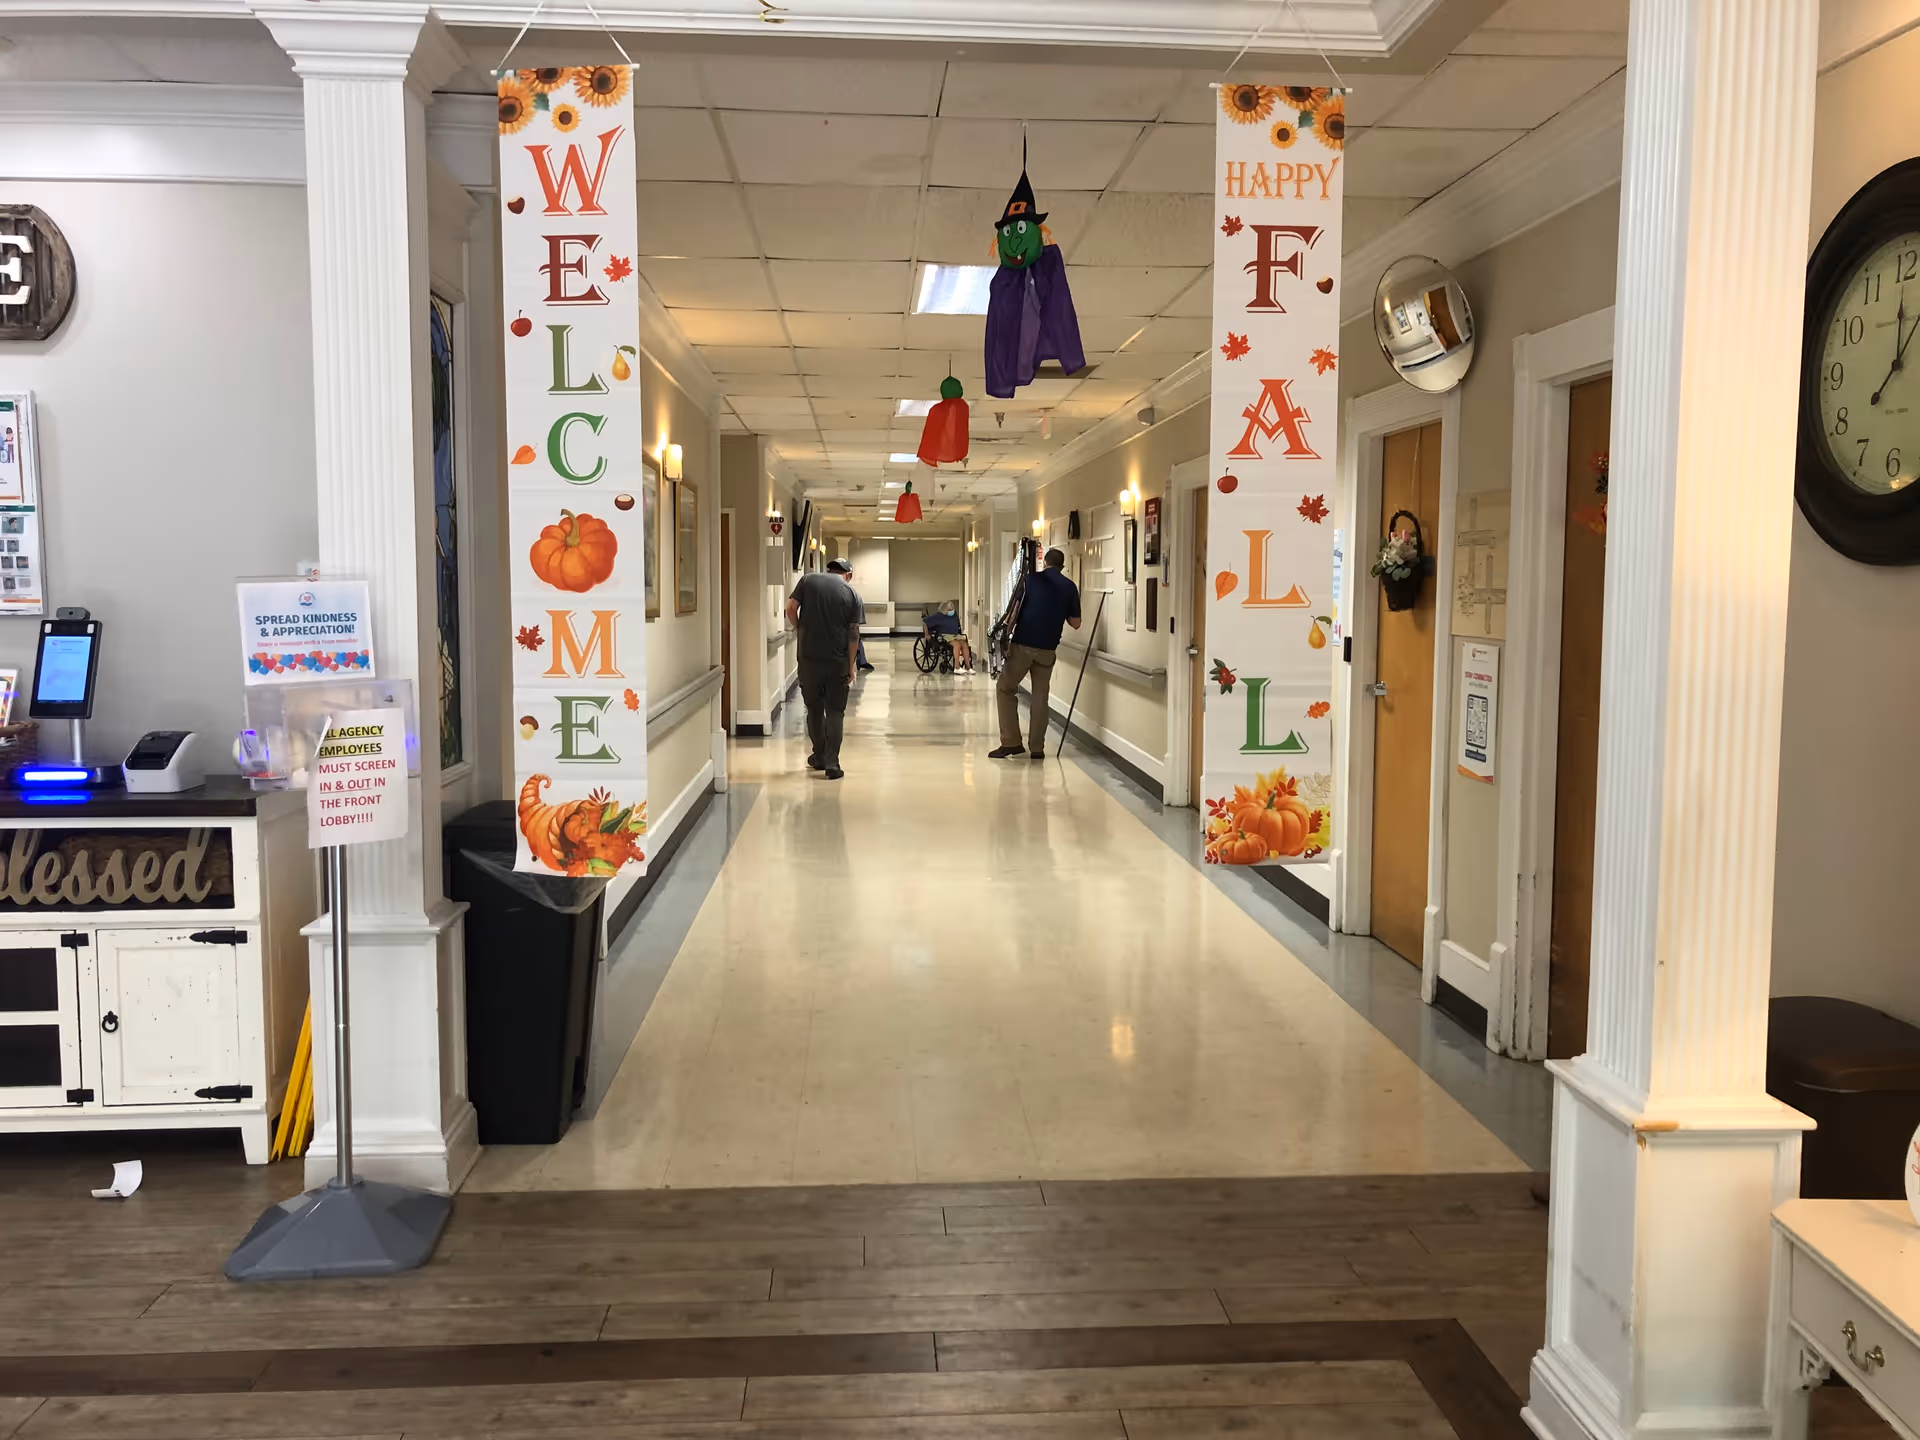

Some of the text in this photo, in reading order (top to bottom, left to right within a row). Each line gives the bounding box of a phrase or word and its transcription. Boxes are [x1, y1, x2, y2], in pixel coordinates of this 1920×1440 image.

[1224, 156, 1340, 200] HAPPY
[1896, 250, 1918, 284] 12
[1864, 272, 1880, 306] 11
[1843, 315, 1864, 347] 10
[1831, 362, 1844, 391] 9
[1835, 407, 1849, 435] 8
[1857, 438, 1870, 467] 7
[1886, 447, 1901, 478] 6
[1225, 224, 1324, 755] FALL
[255, 612, 357, 625] SPREAD KINDNESS
[260, 624, 355, 637] & APPRECIATION!
[325, 725, 384, 738] LL AGENCY
[319, 743, 382, 756] EMPLOYEES
[318, 759, 396, 774] MUST SCREEN
[320, 777, 386, 792] IN & OUT IN
[320, 795, 382, 809] THE FRONT
[320, 812, 373, 827] LOBBY!!!!
[0, 828, 213, 905] lessed
